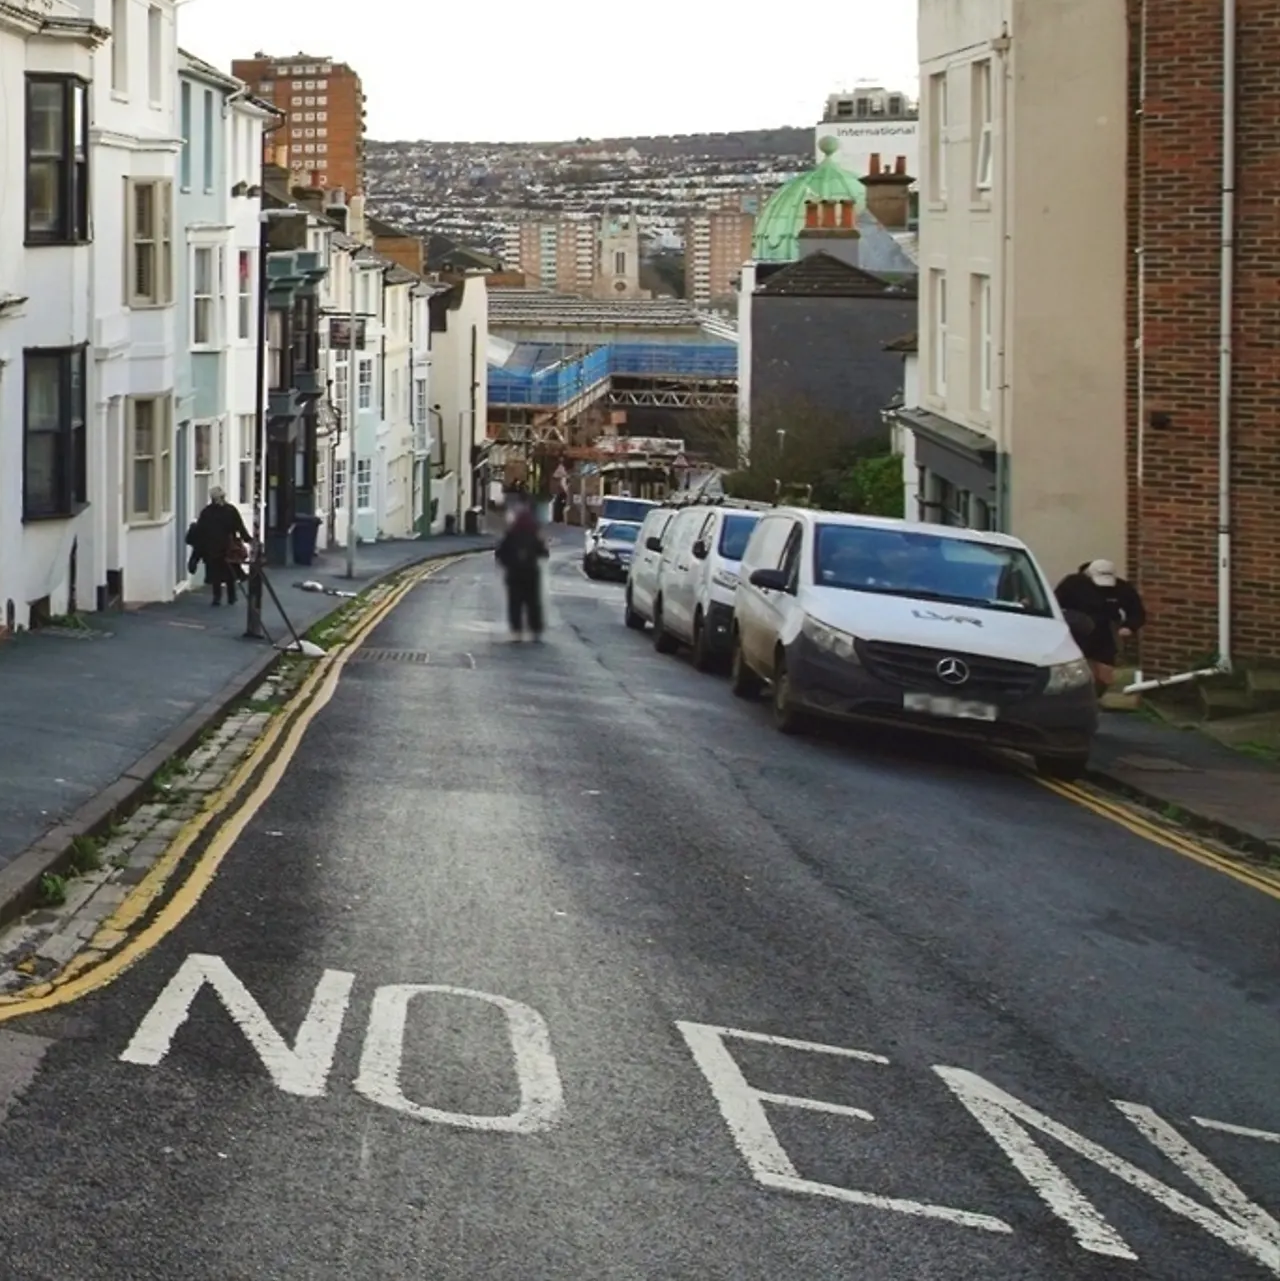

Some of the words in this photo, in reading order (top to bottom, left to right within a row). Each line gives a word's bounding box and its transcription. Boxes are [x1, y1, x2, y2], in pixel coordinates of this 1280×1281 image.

[837, 125, 915, 137] International
[117, 952, 566, 1134] NO
[674, 1019, 1280, 1278] EN
